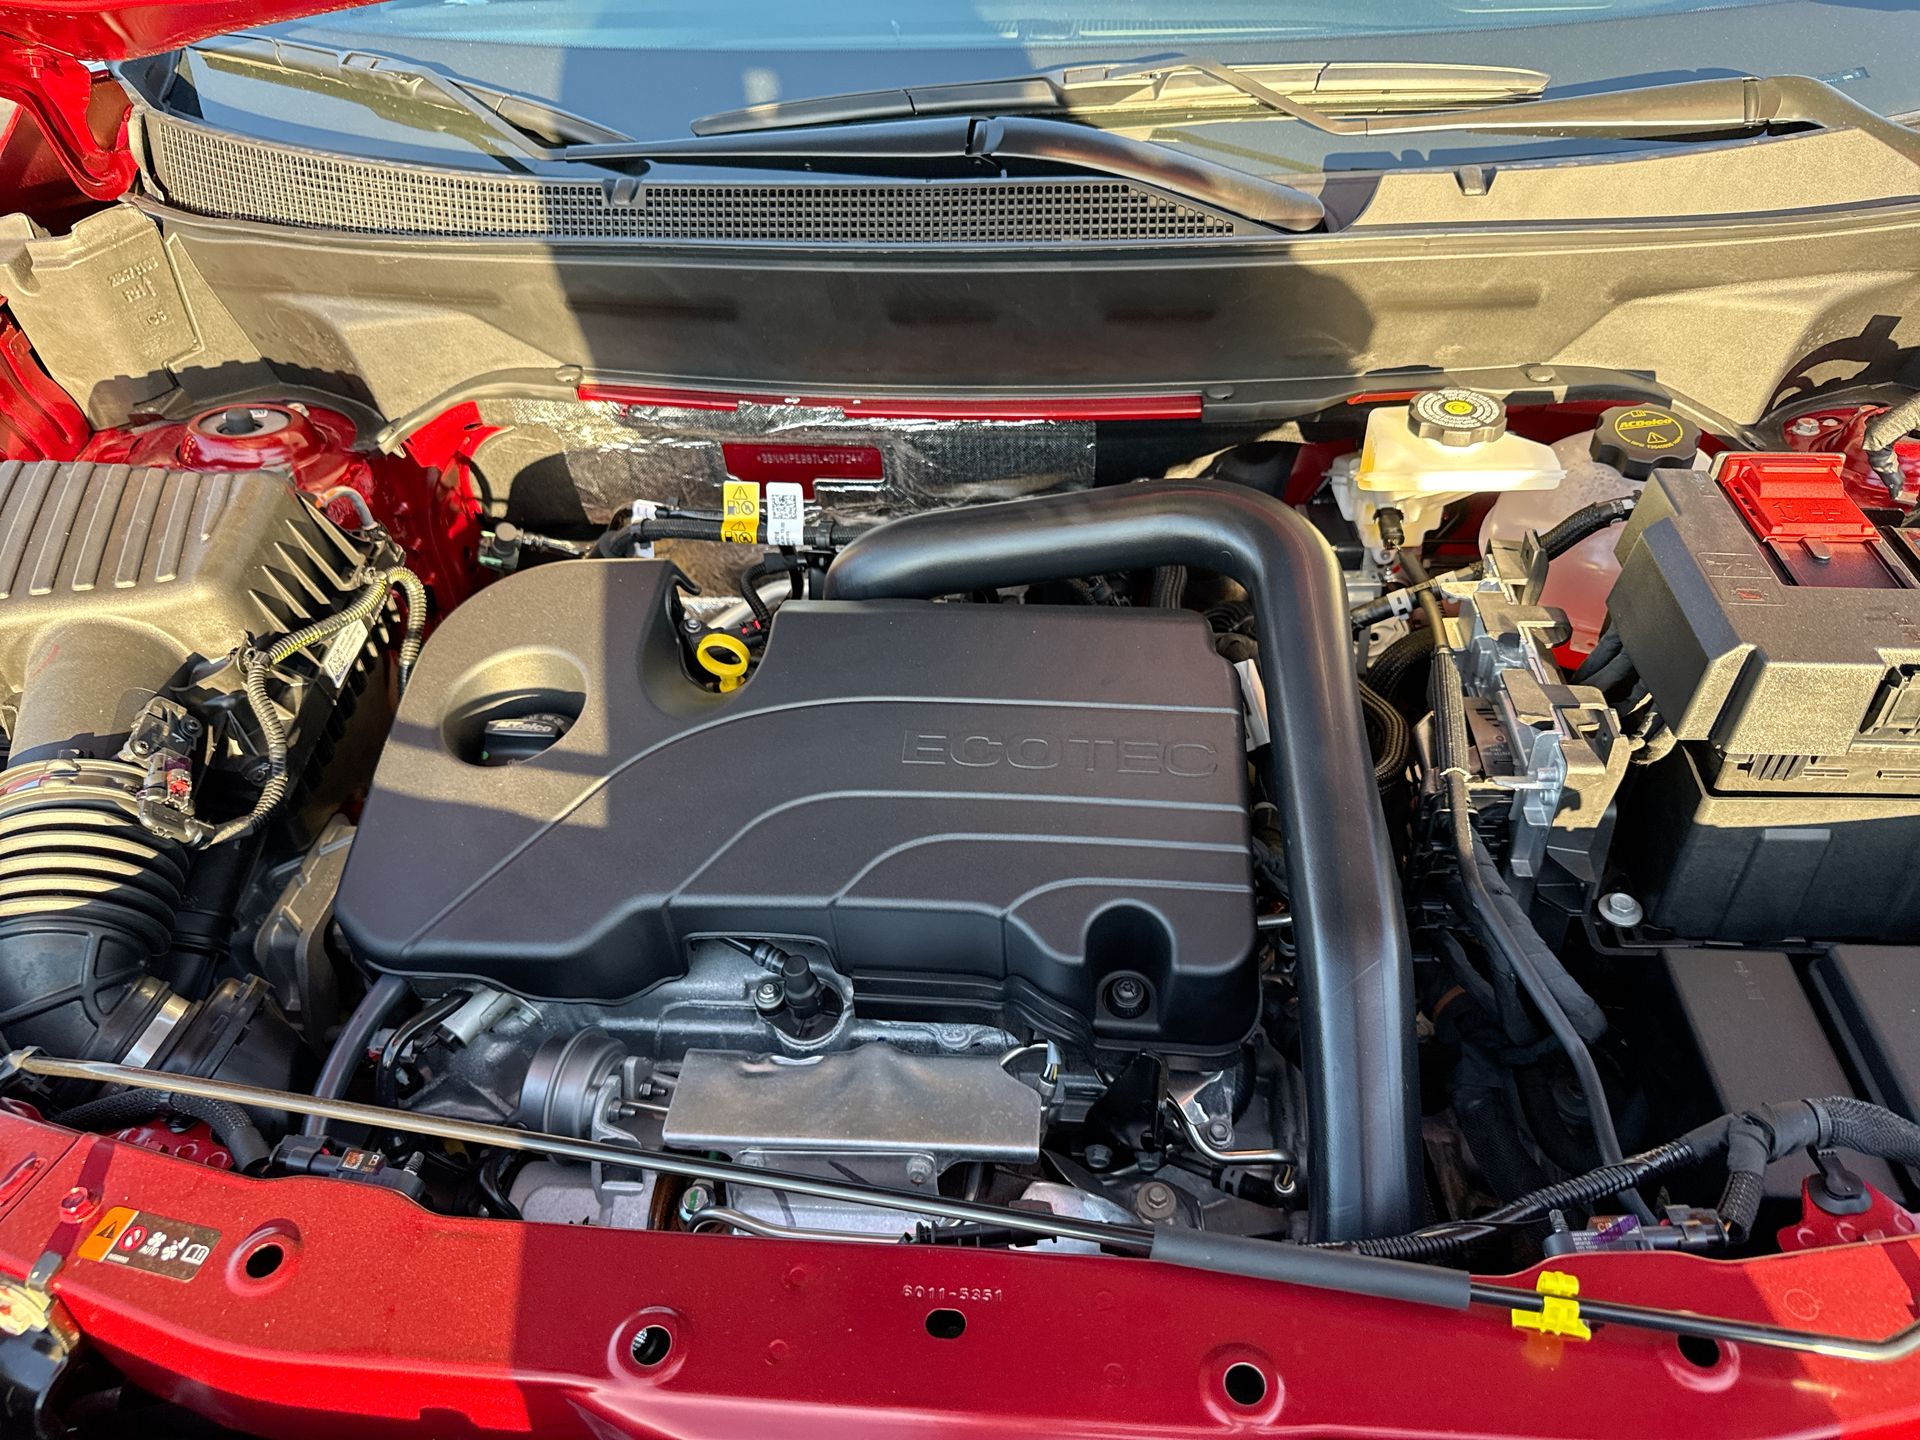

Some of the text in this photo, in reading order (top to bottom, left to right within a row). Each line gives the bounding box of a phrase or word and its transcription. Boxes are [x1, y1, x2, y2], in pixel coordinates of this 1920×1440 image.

[901, 729, 1218, 778] ECOTEC
[368, 1154, 380, 1166] B
[138, 1245, 160, 1257] AUTO
